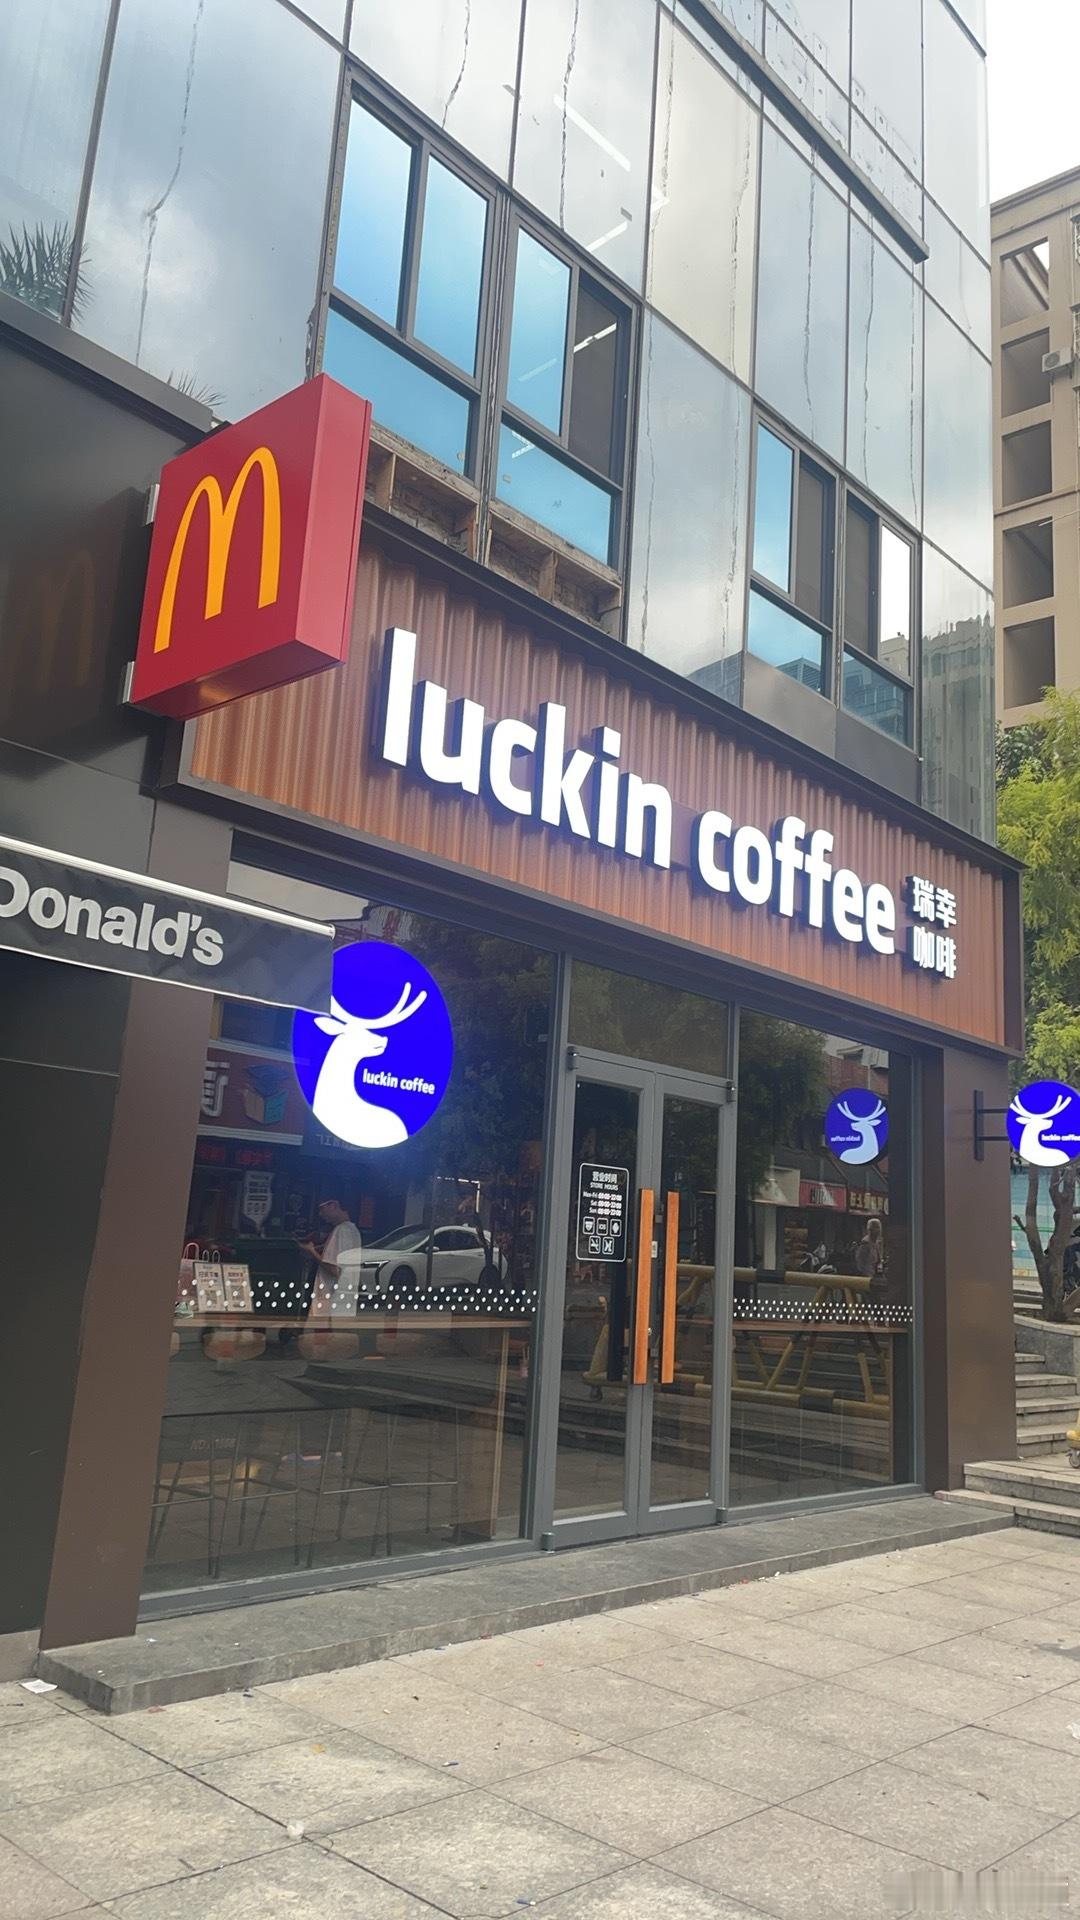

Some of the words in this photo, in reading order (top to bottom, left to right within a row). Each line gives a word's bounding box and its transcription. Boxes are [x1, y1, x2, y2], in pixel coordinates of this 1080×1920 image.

[383, 627, 672, 869] luckin
[698, 810, 896, 955] coffee
[912, 875, 957, 929] 瑞幸
[912, 925, 957, 979] 咖啡
[362, 1068, 398, 1089] luckin
[400, 1077, 436, 1095] coffee
